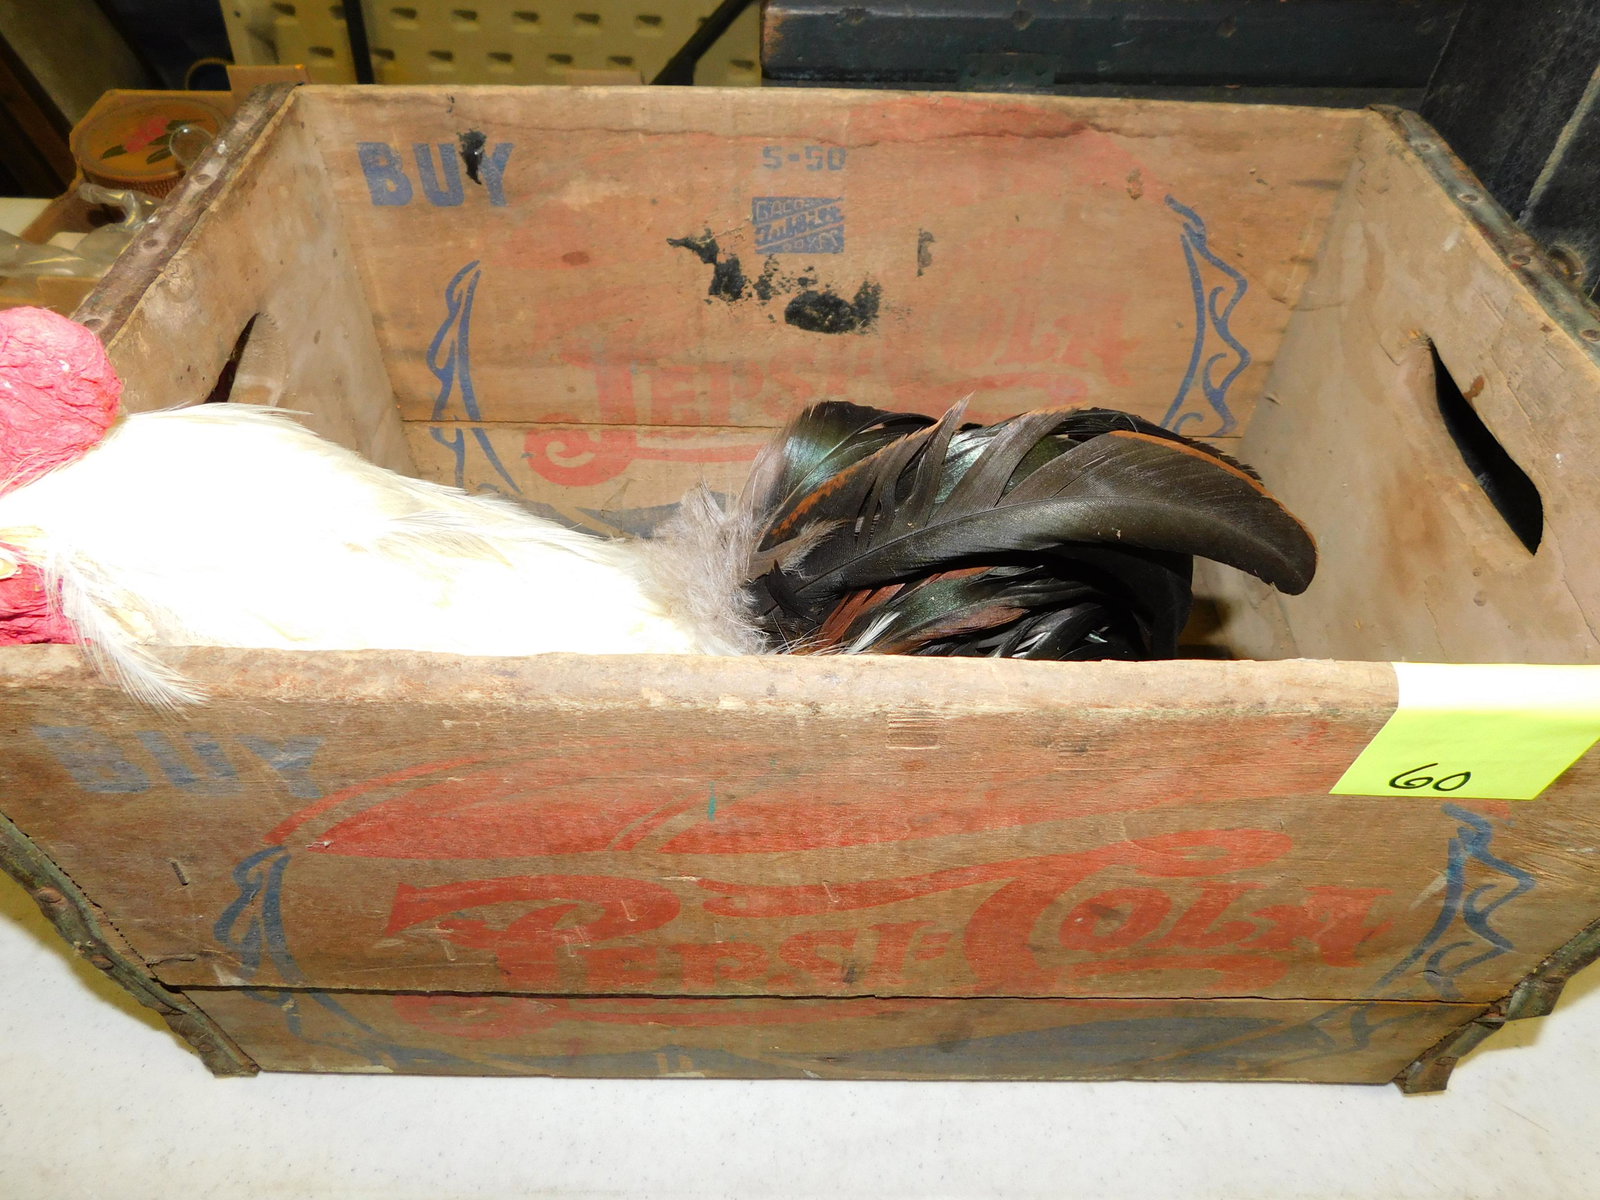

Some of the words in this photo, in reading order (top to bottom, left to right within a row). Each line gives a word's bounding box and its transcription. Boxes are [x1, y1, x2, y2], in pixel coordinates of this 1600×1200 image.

[356, 142, 515, 207] BUY
[31, 725, 325, 798] BUY
[1389, 763, 1471, 791] 60
